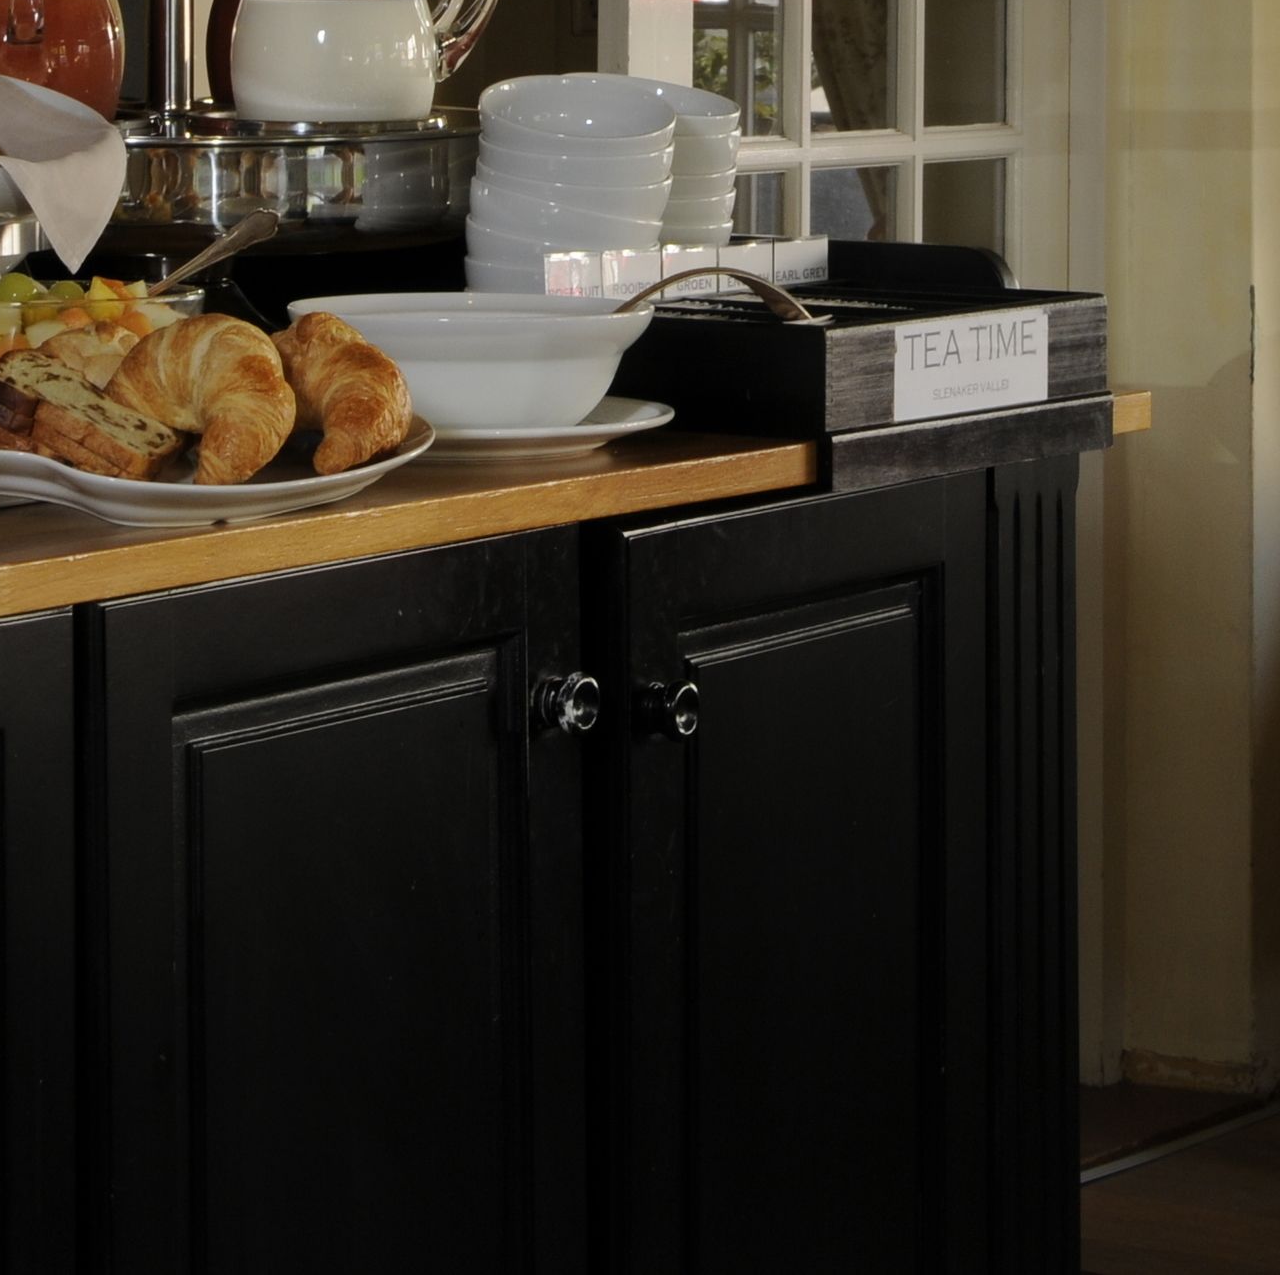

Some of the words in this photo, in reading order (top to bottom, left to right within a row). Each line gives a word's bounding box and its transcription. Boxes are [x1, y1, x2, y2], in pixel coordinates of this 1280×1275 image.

[775, 269, 801, 282] EARL
[802, 267, 827, 280] GREY
[612, 280, 657, 296] ROOIB
[676, 278, 713, 292] GROEN
[903, 329, 962, 371] TEA
[969, 319, 1037, 362] TIME
